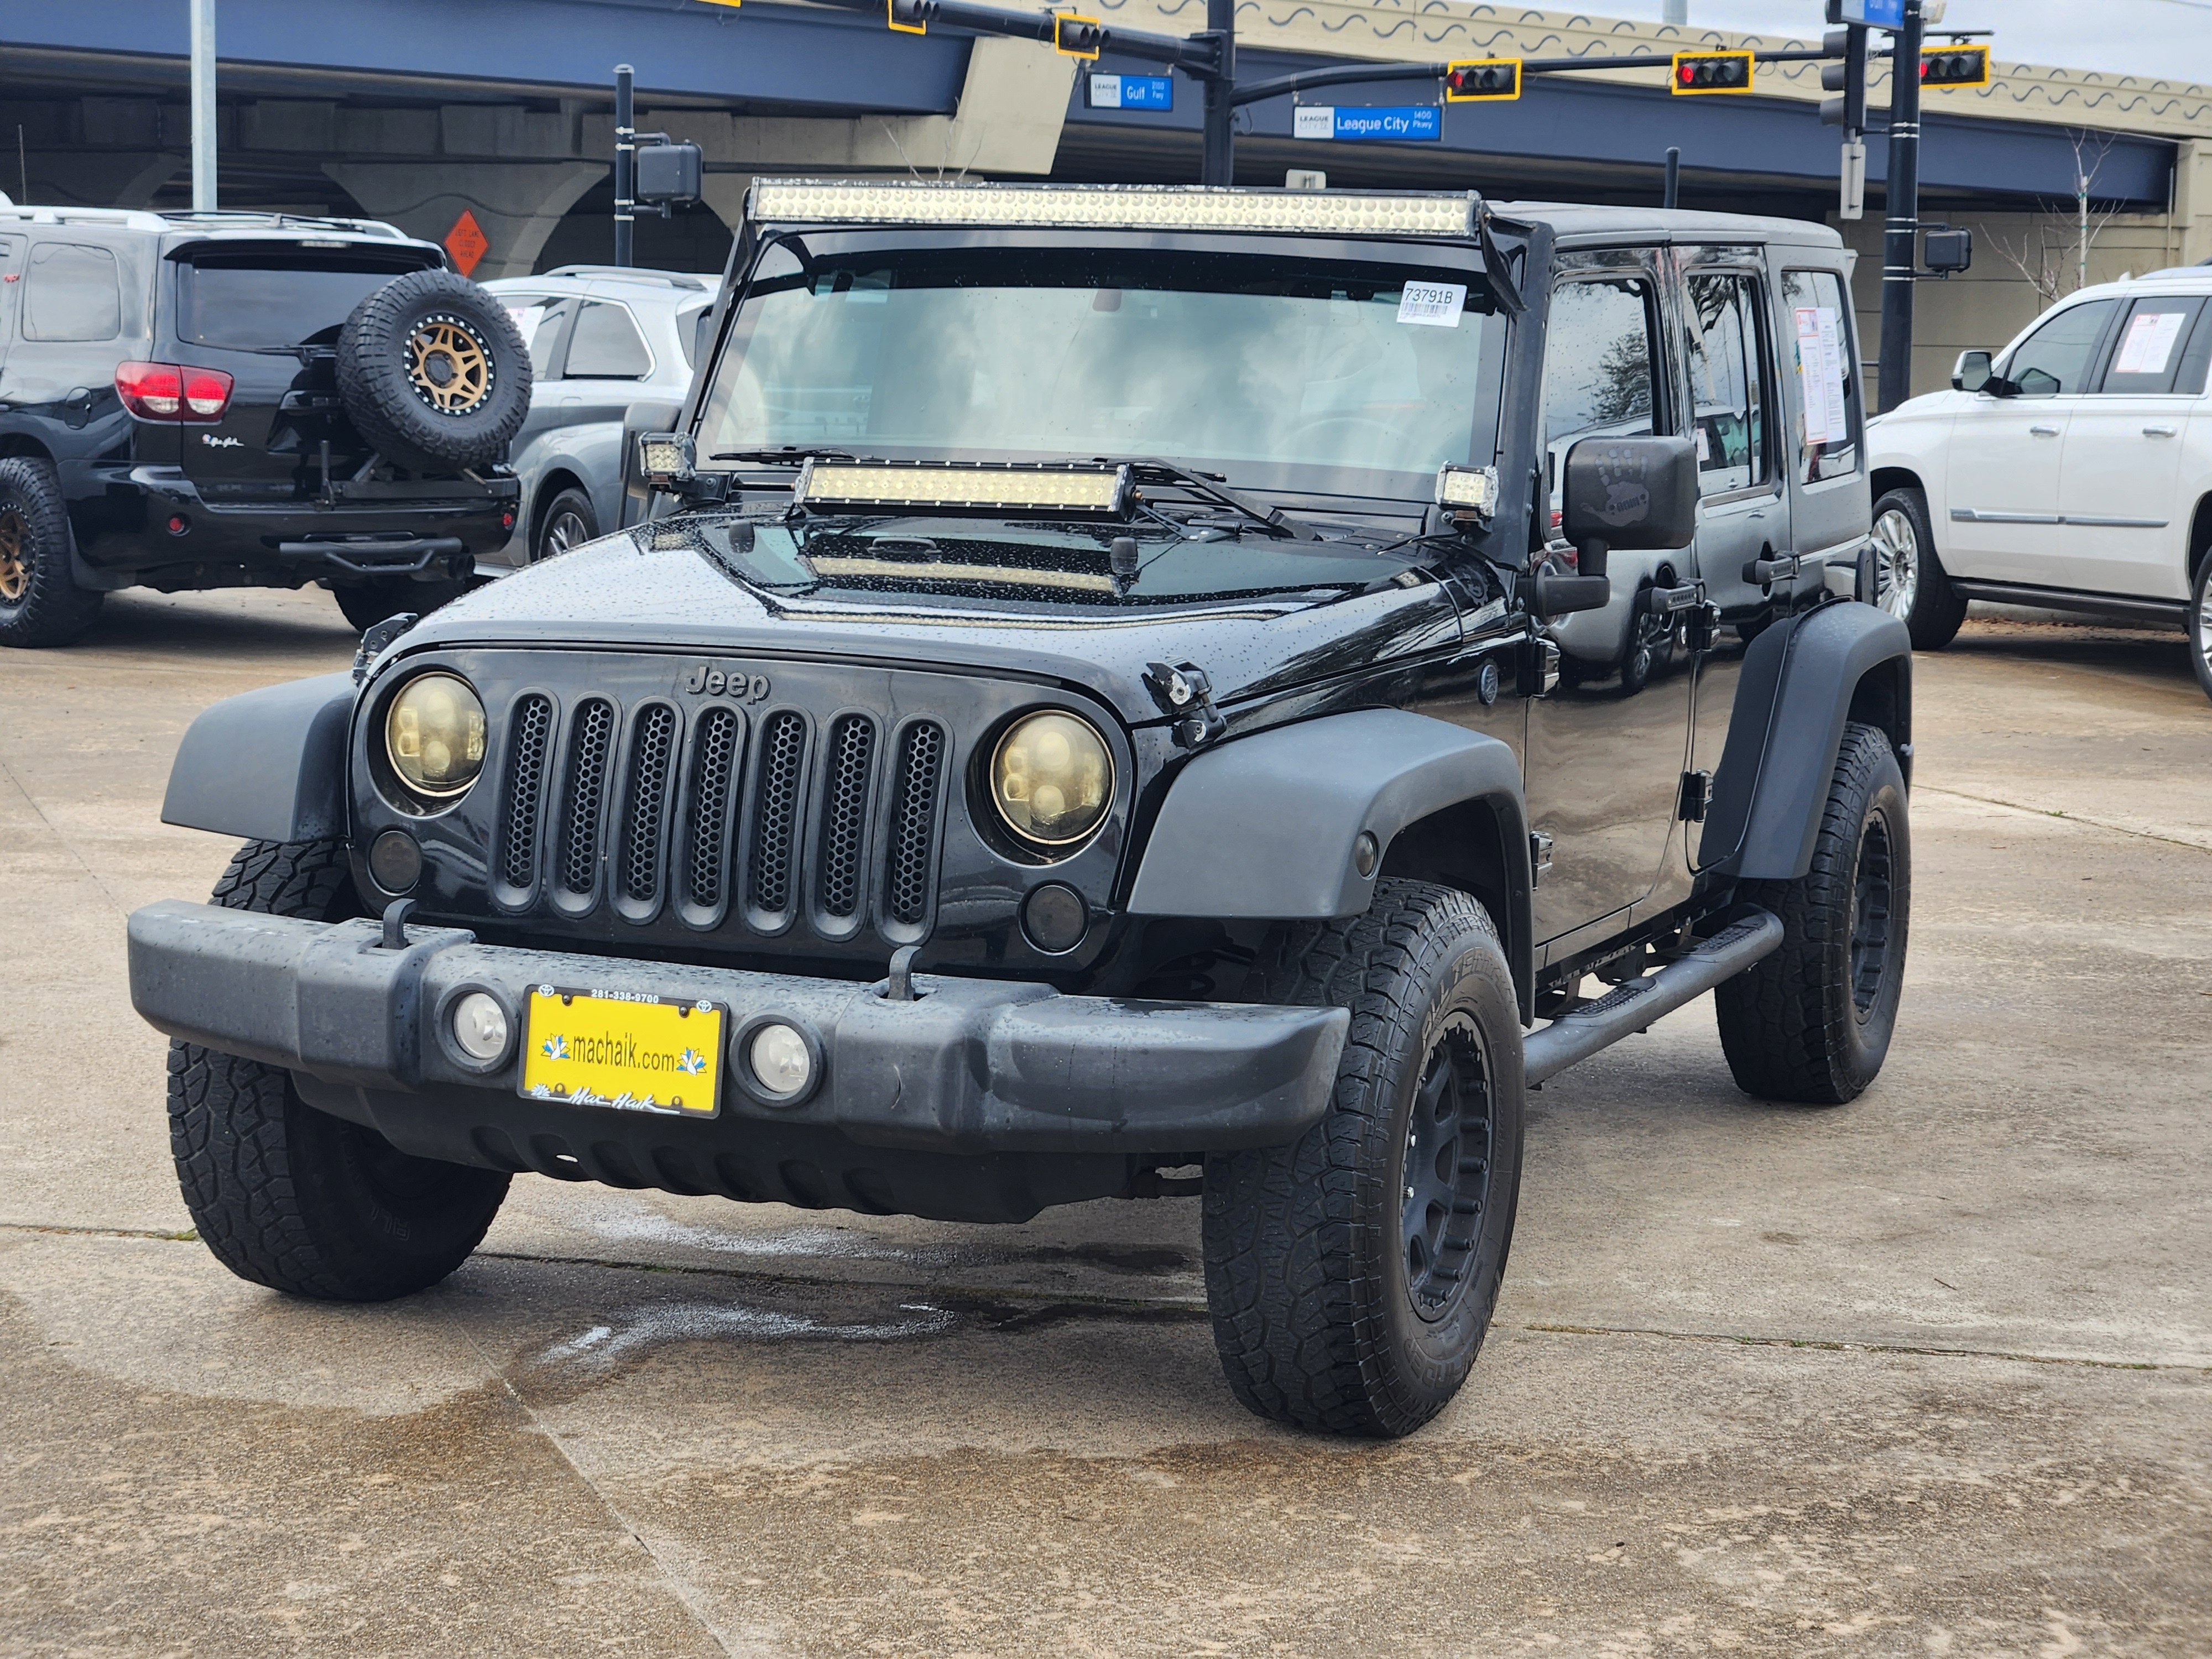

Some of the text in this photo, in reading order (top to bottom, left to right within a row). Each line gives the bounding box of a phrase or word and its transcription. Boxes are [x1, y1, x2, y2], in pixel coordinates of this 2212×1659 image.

[1126, 85, 1145, 100] Gulf
[1413, 111, 1432, 119] 1400
[1337, 117, 1410, 134] League City
[1412, 119, 1433, 129] Pkwy
[1405, 288, 1453, 304] 73791B
[684, 666, 771, 705] Jeep
[591, 989, 659, 1004] 281-338-9700
[573, 1031, 675, 1072] machaik.com
[568, 1086, 609, 1106] Mac
